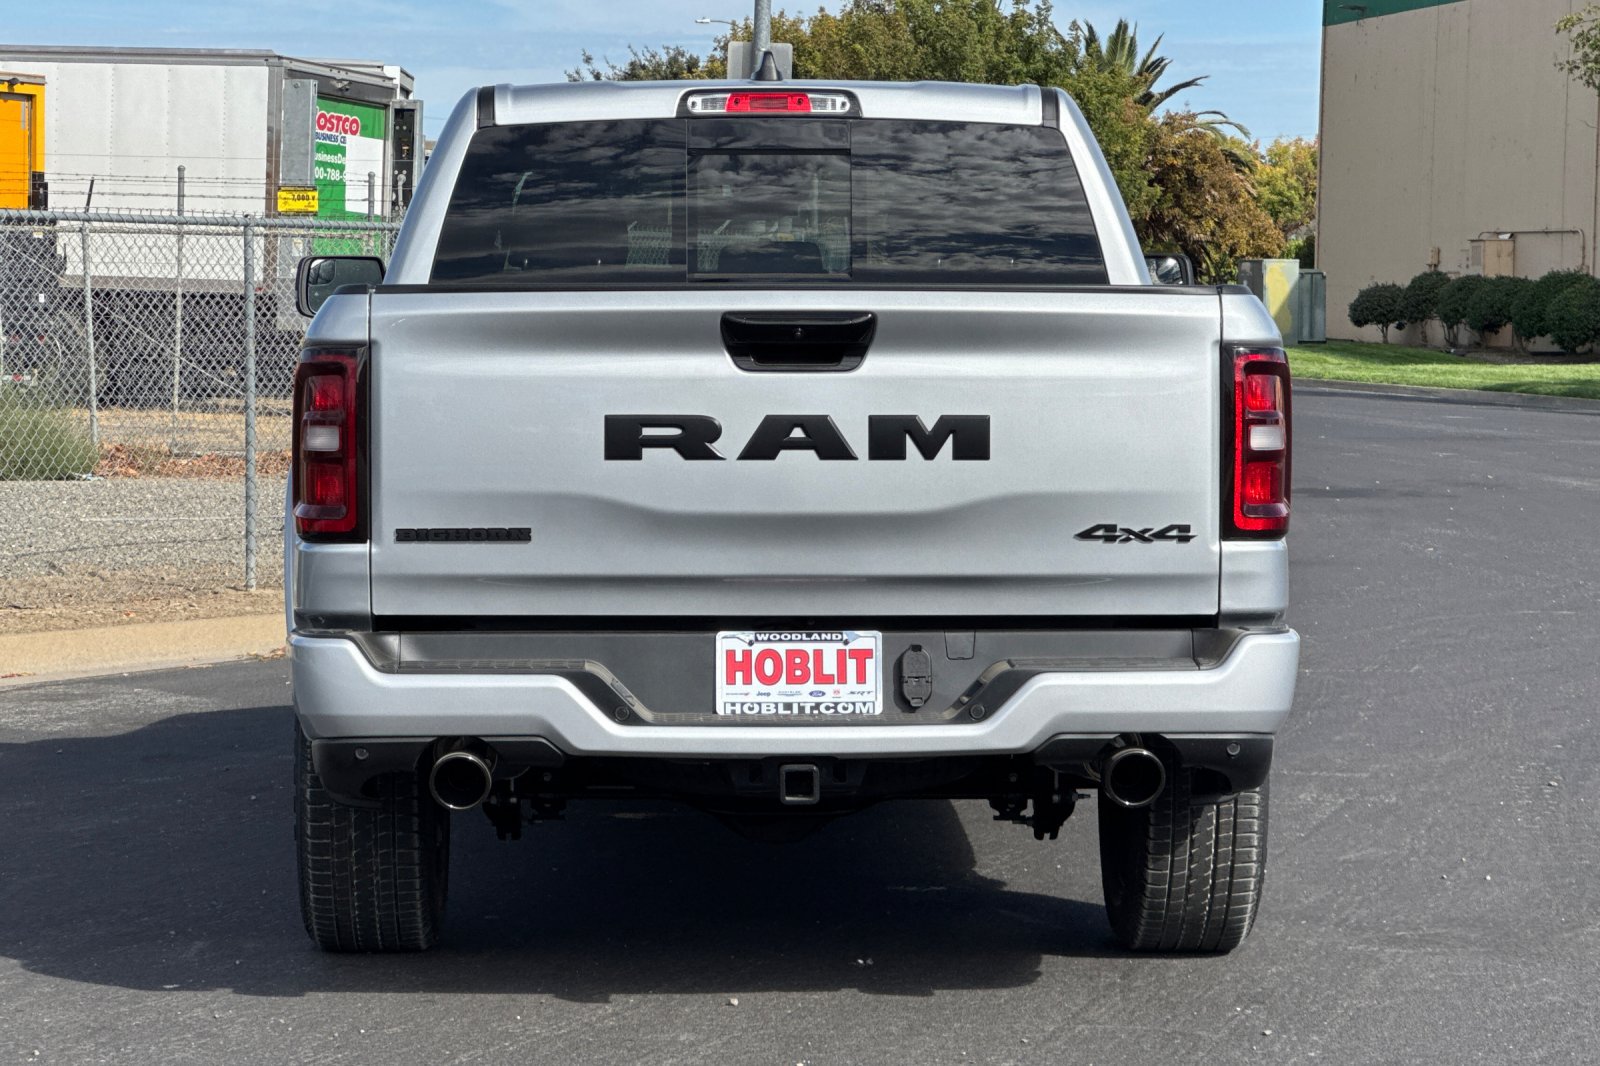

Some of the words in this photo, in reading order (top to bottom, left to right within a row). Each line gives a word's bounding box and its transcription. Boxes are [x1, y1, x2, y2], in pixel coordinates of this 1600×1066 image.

[316, 112, 360, 136] OSTCO
[604, 414, 991, 461] RAM
[1073, 523, 1197, 544] 4x4
[755, 633, 842, 641] WOODLAND
[725, 649, 874, 686] HOBLIT
[725, 702, 875, 715] HOBLIT.COM
